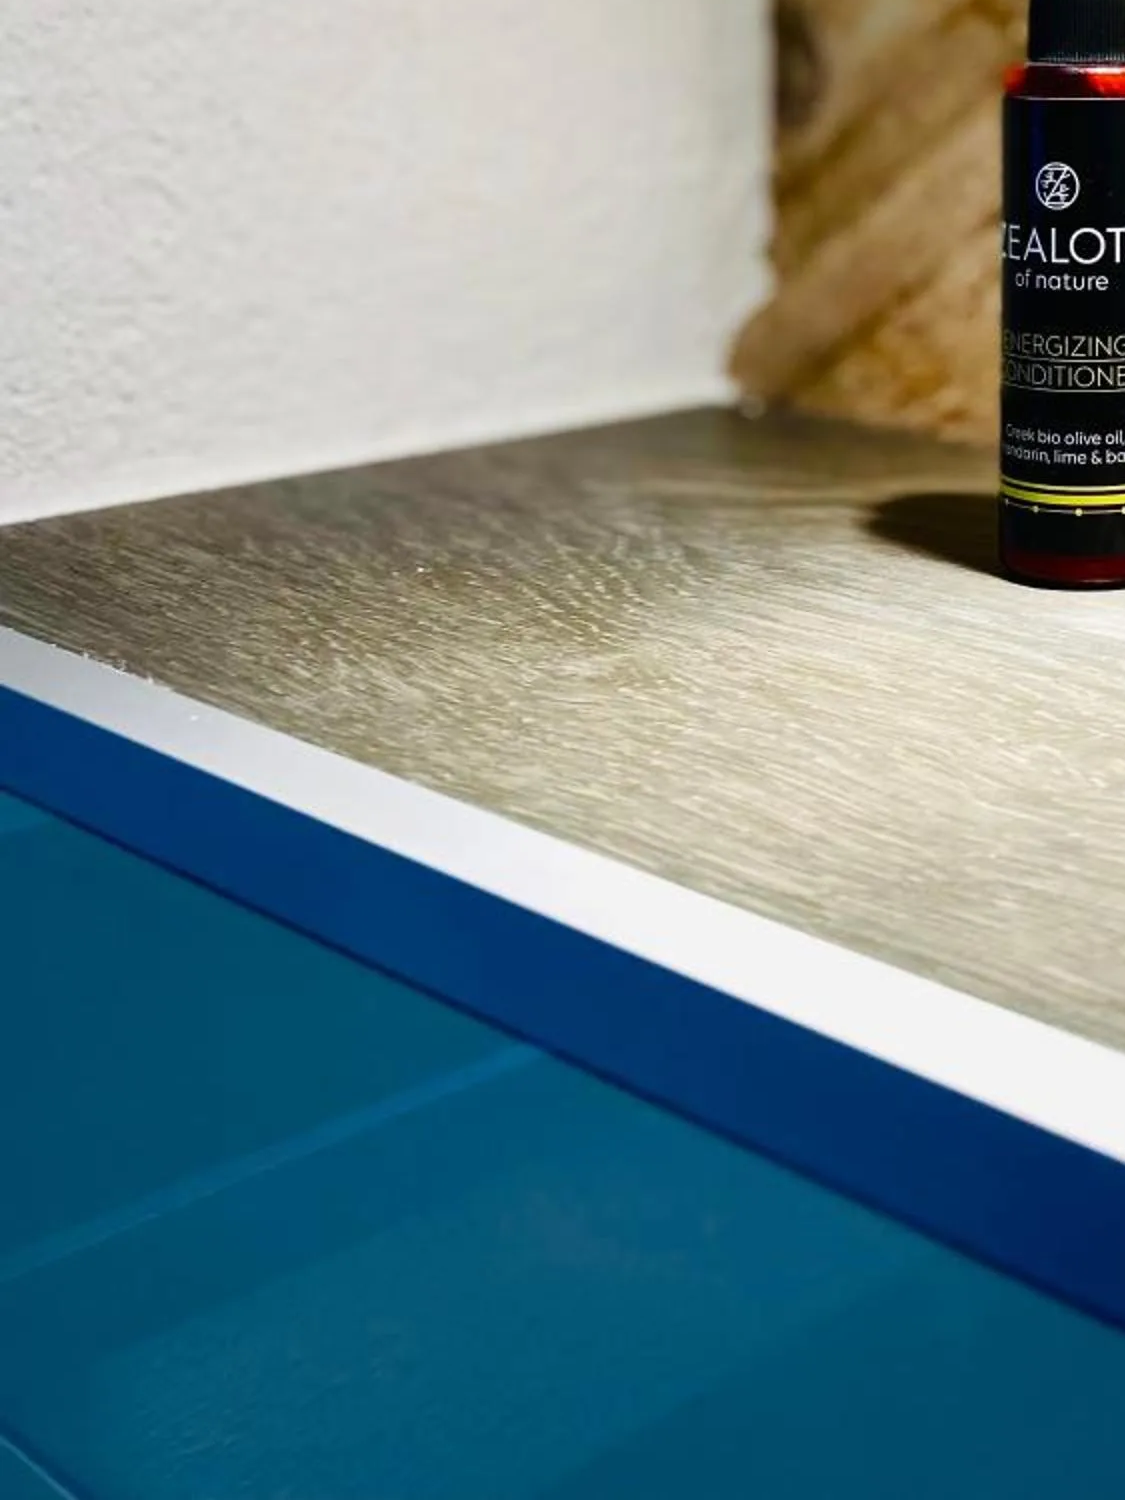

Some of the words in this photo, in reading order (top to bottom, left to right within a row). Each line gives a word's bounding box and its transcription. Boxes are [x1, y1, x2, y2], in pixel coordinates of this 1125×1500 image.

[1014, 268, 1031, 289] of
[1035, 273, 1110, 291] nature
[1037, 429, 1061, 446] bio
[1063, 430, 1101, 446] olive
[1003, 444, 1051, 465] andarin,
[1053, 449, 1087, 466] lime
[1090, 450, 1103, 466] &
